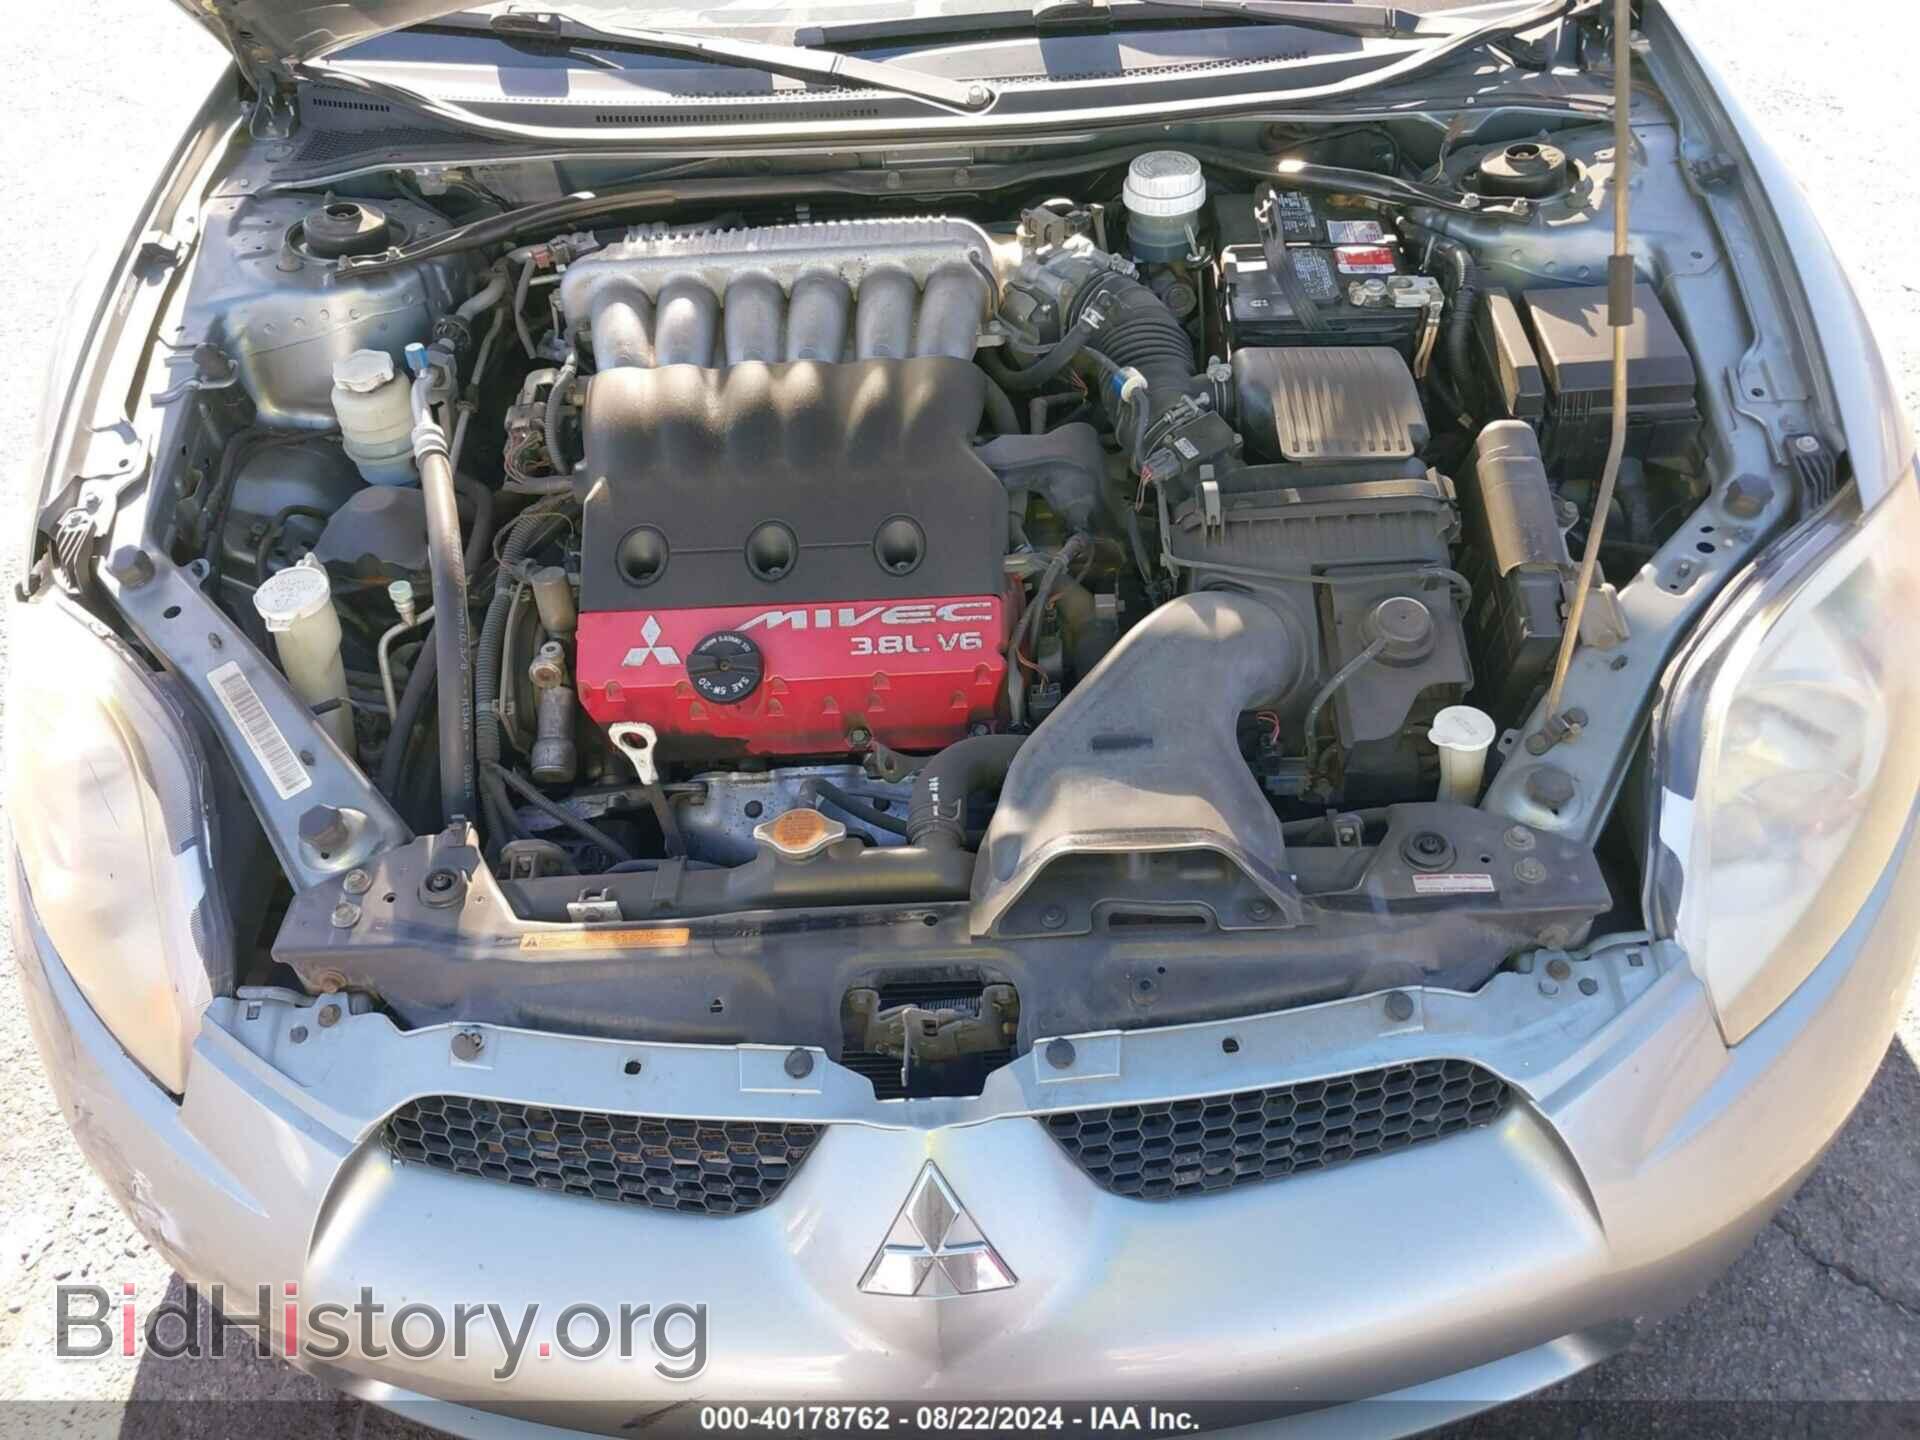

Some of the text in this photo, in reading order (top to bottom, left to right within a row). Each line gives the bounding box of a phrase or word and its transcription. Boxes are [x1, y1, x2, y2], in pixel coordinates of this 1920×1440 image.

[735, 602, 992, 631] MIVEC
[850, 631, 982, 656] 3.8L V6
[730, 676, 750, 693] SAE
